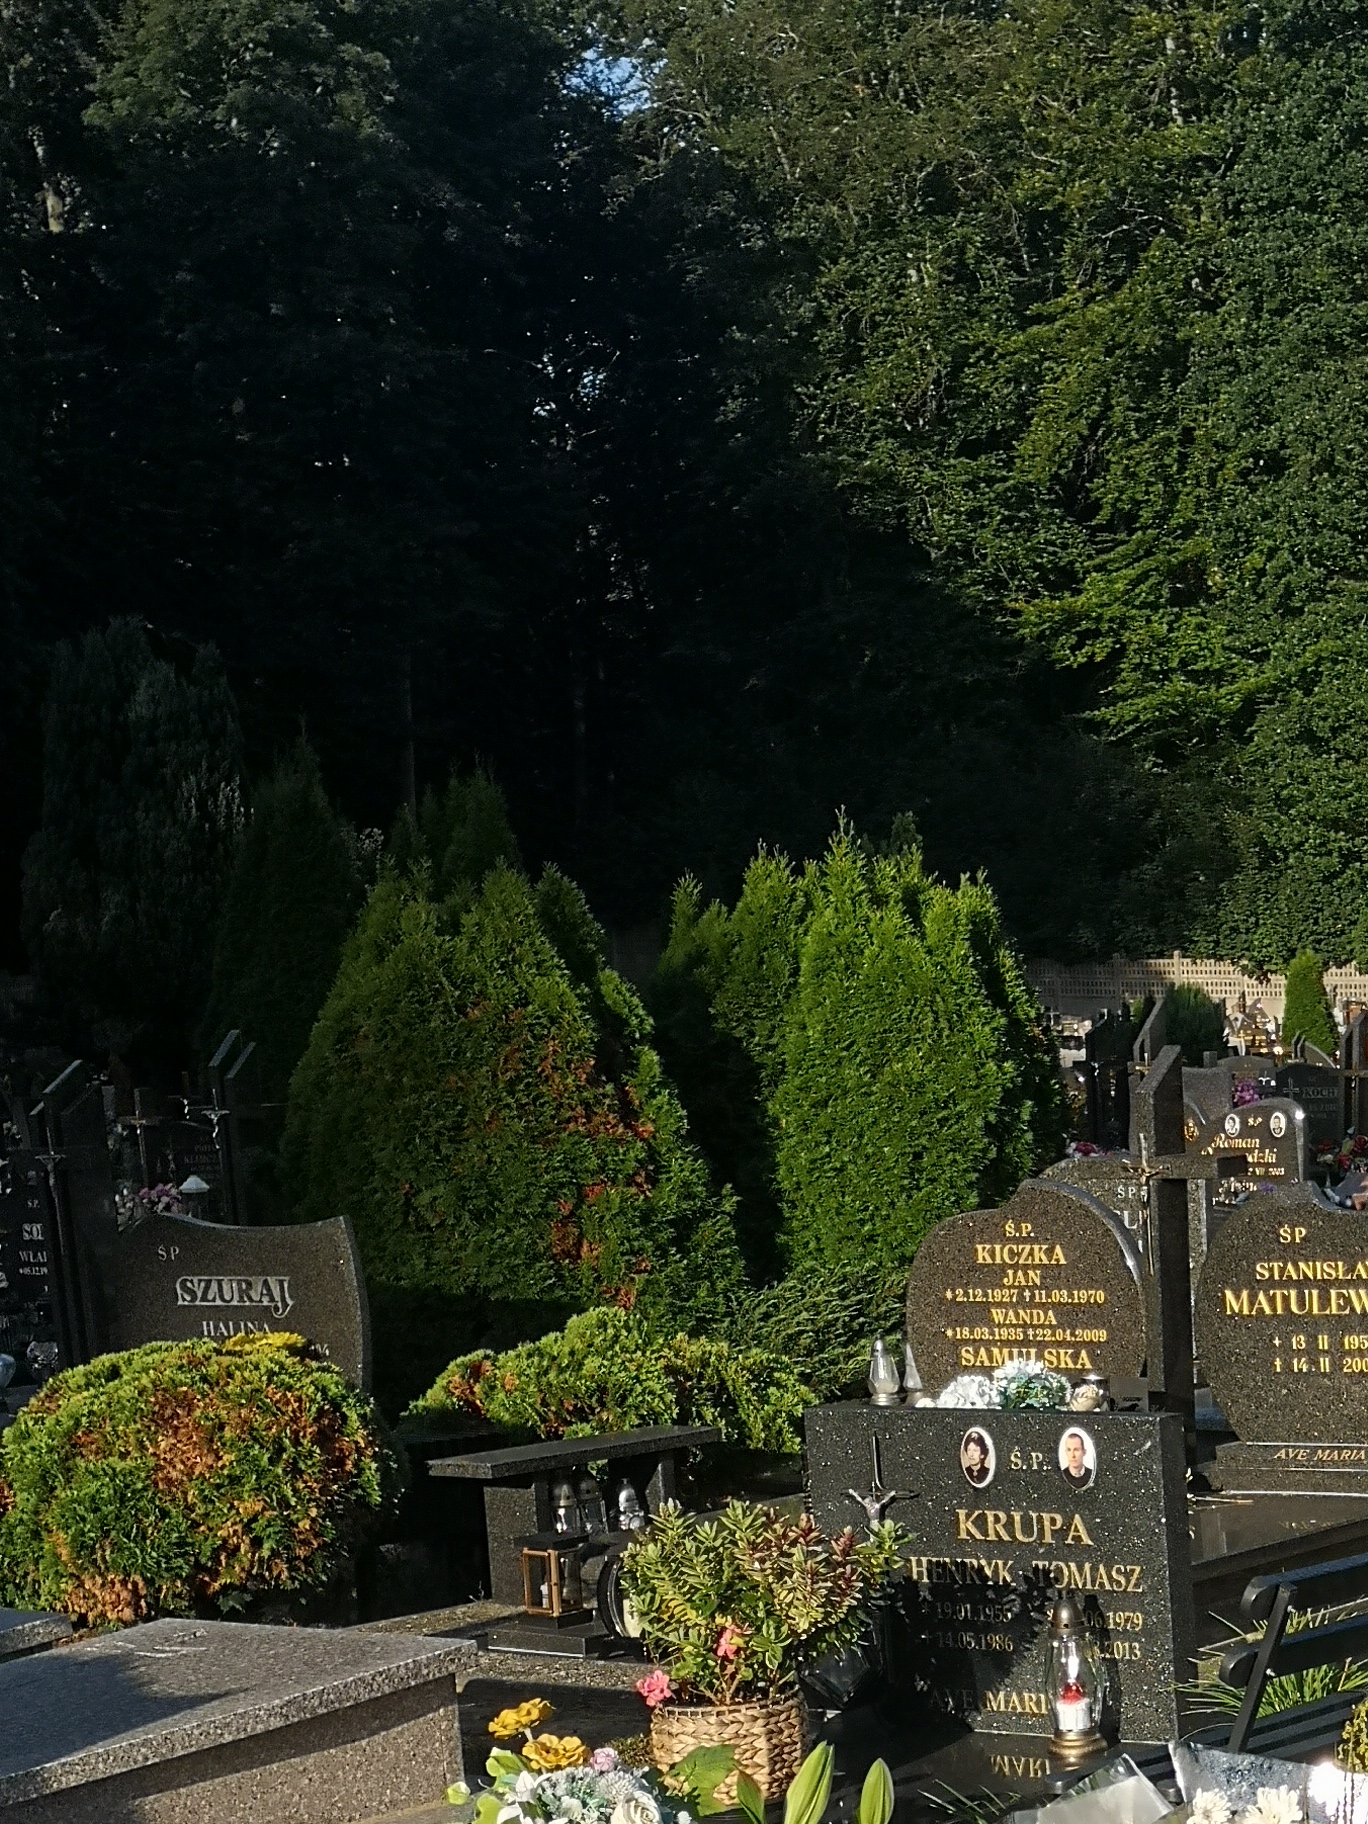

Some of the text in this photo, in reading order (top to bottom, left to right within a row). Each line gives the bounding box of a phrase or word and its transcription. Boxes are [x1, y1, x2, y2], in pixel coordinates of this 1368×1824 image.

[976, 1244, 1067, 1265] KICZKA
[1003, 1270, 1041, 1286] JAN
[178, 1277, 293, 1317] SZURAJ
[1034, 1289, 1105, 1304] 11.03.1970
[991, 1309, 1057, 1325] WANDA
[956, 1327, 1107, 1342] 18.03.1935 22.04.2009
[1291, 1335, 1306, 1350] 13
[1273, 1449, 1366, 1461] AVE MARIA
[956, 1508, 1094, 1546] KRUPA
[909, 1556, 1143, 1594] HENRYK TOMASZ
[985, 1691, 1049, 1714] MARI
